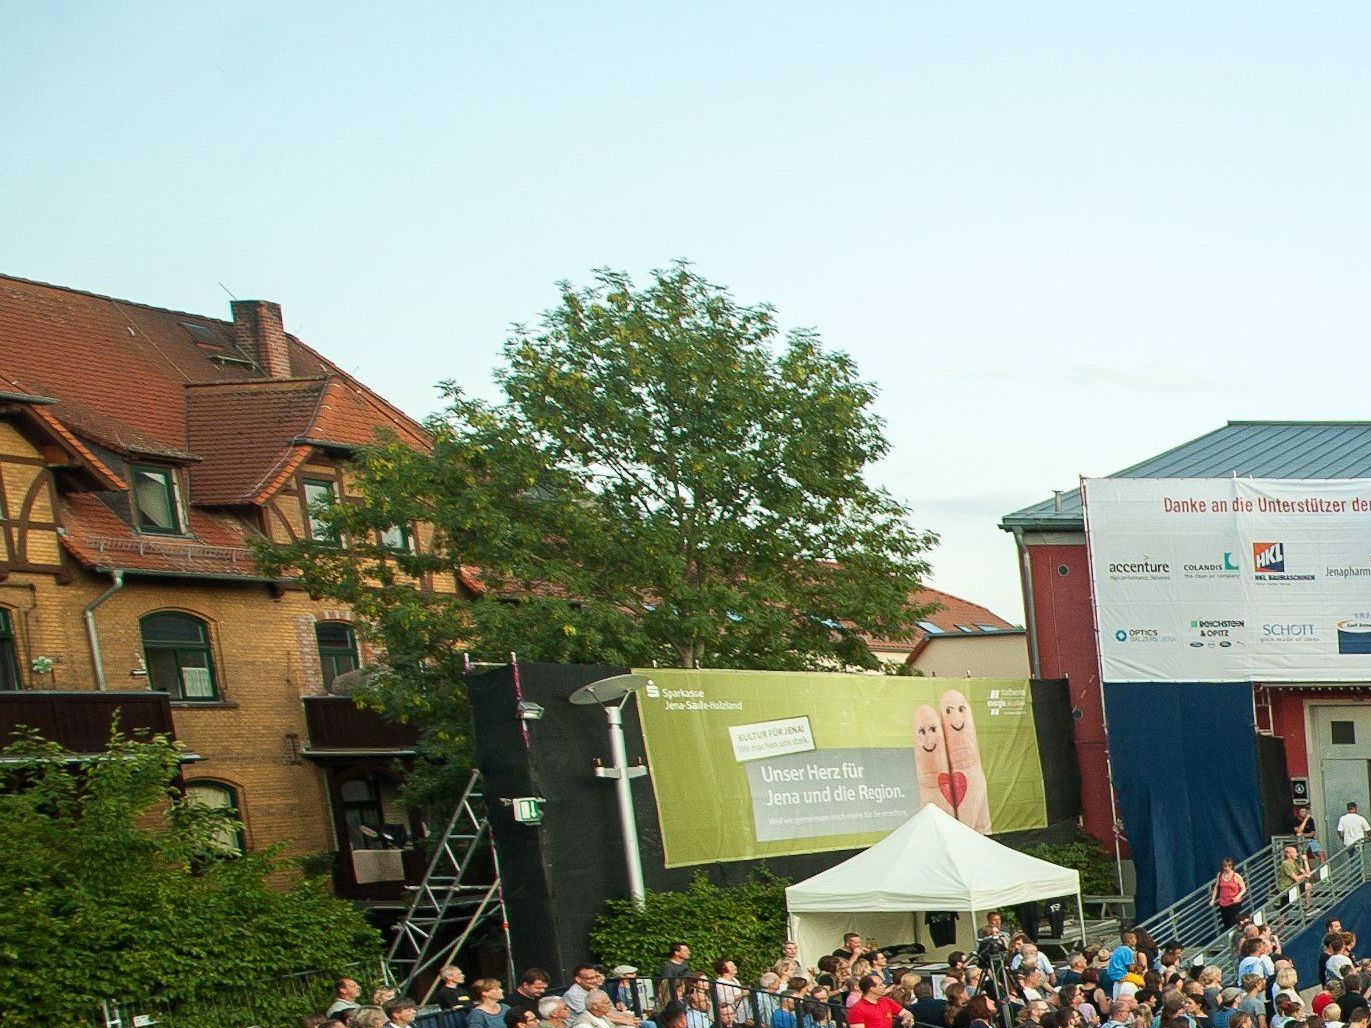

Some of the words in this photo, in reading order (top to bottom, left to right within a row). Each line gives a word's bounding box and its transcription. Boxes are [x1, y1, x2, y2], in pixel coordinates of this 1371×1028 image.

[1163, 498, 1207, 513] Danke
[1211, 500, 1228, 513] an
[1232, 497, 1253, 513] die
[1257, 497, 1347, 513] Unterstützer
[1256, 543, 1283, 568] HKL
[1109, 562, 1170, 573] accenture
[1326, 567, 1371, 579] Jenapharm
[1262, 624, 1315, 636] SCHOTT
[661, 688, 705, 699] Sparkasse
[738, 730, 767, 742] KULTUR
[768, 727, 783, 738] FÜR
[761, 765, 804, 783] Unser
[807, 764, 840, 781] Herz
[842, 762, 864, 779] für
[766, 790, 800, 806] Jena
[803, 786, 831, 802] und
[835, 785, 856, 801] die
[858, 783, 906, 804] Region.
